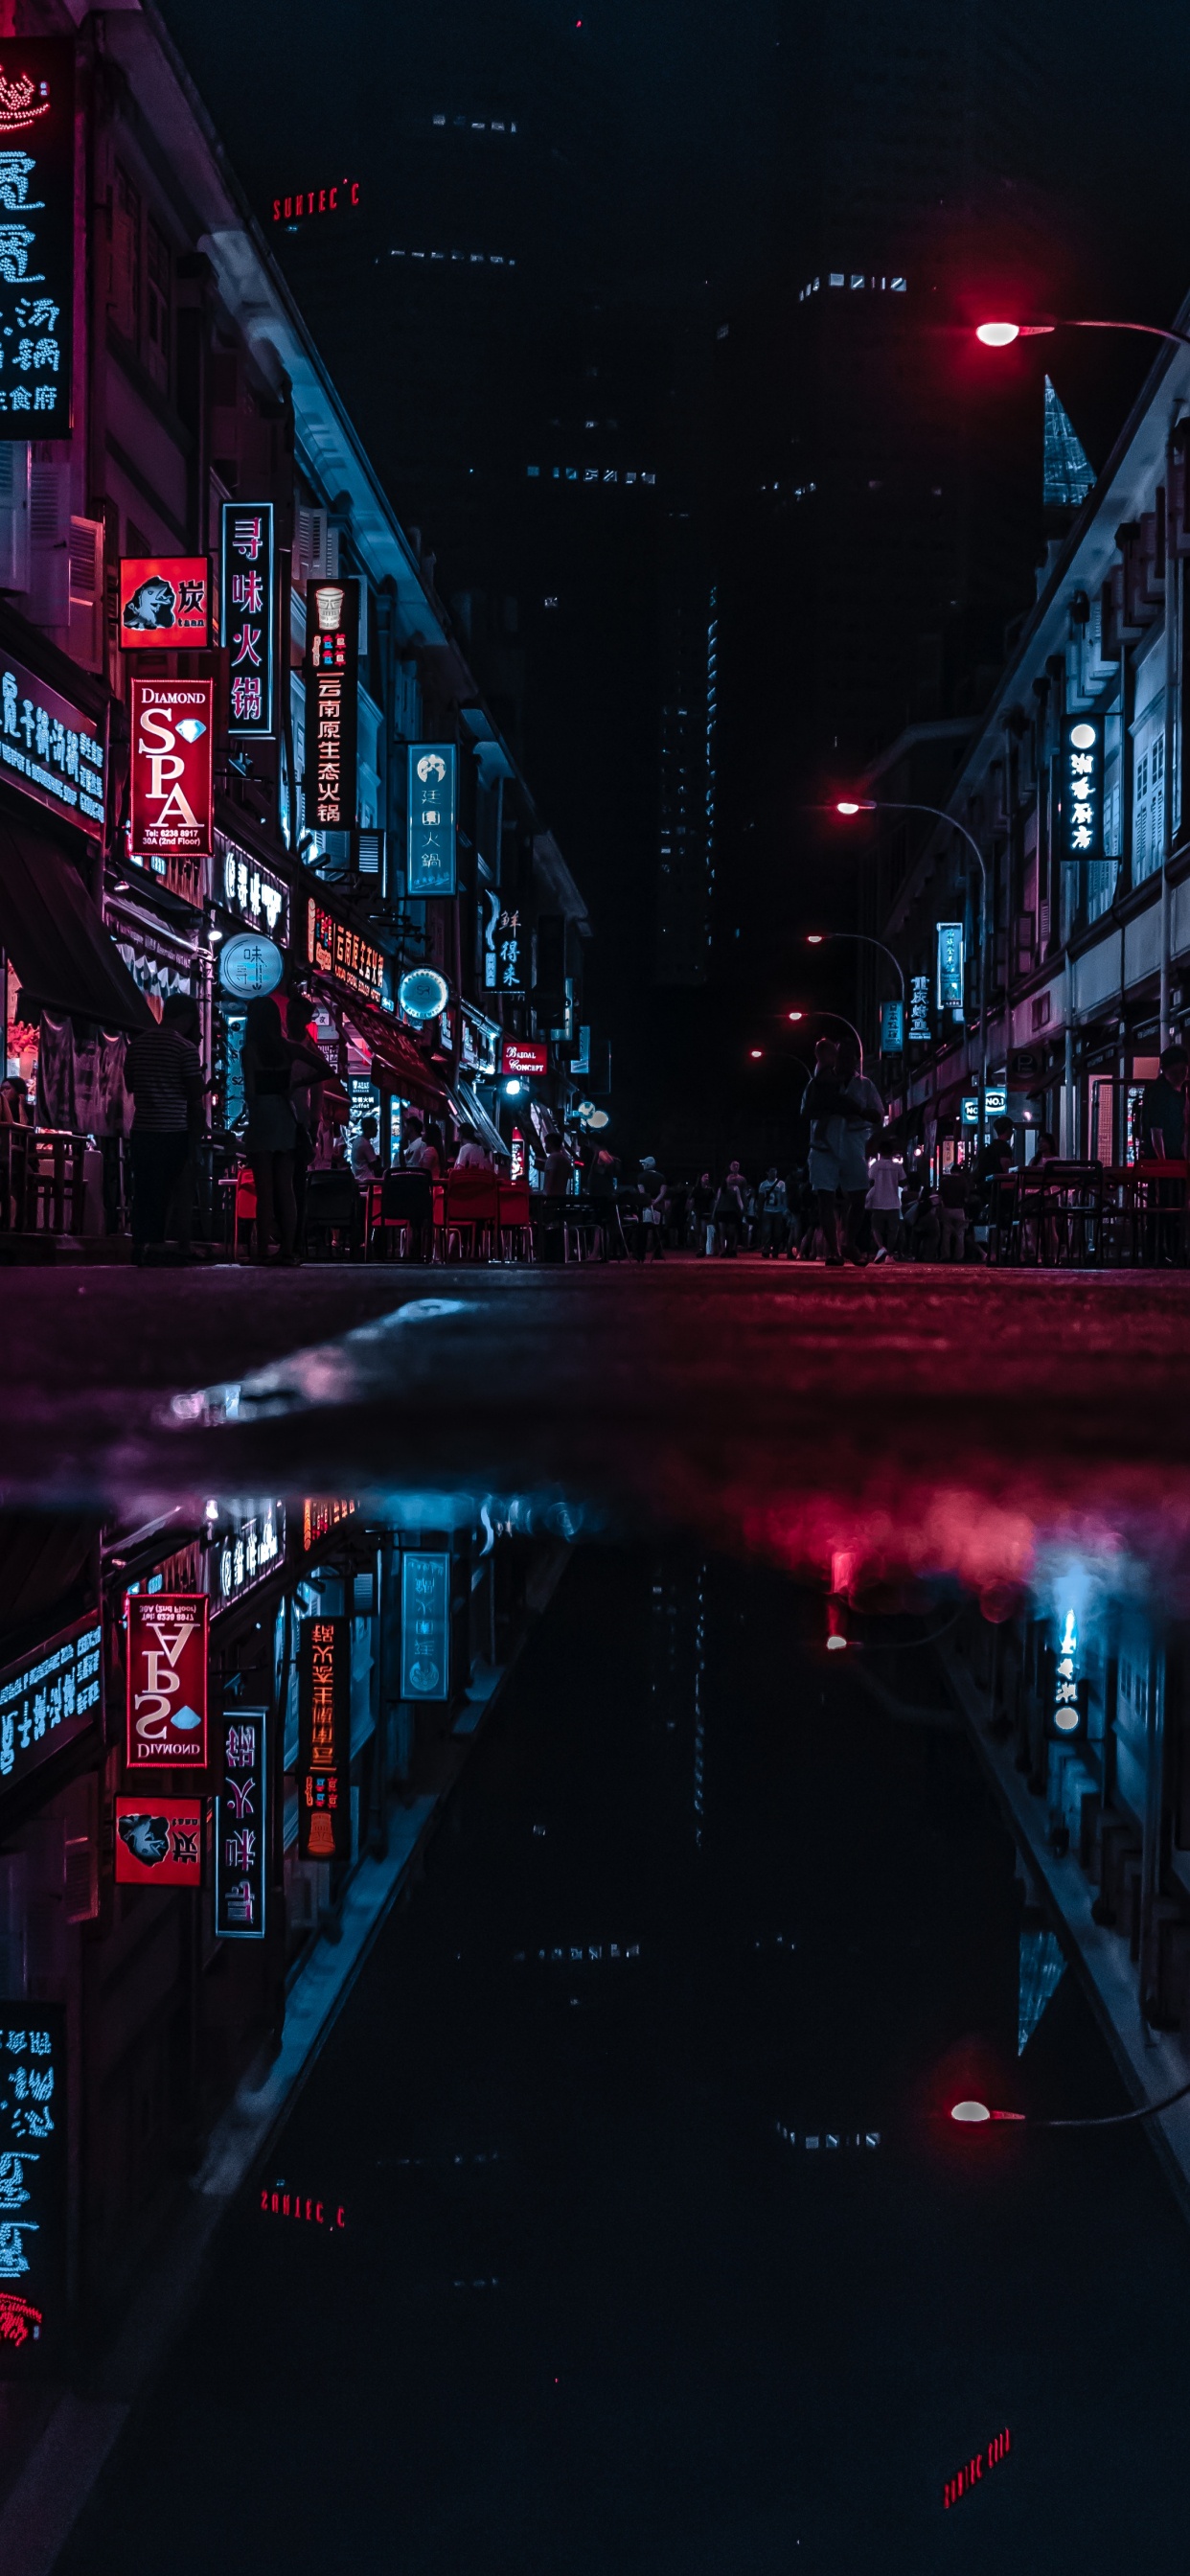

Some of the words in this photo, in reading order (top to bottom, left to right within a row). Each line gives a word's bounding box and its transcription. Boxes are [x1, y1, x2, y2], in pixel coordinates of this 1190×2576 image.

[178, 579, 205, 613] 炭
[231, 517, 263, 721] 寻味火锅
[138, 707, 205, 827] SPA
[316, 679, 341, 822] 云南原生态火锅
[159, 838, 176, 846] (2nd
[177, 838, 200, 846] Floor)
[985, 1097, 1004, 1106] NO.1
